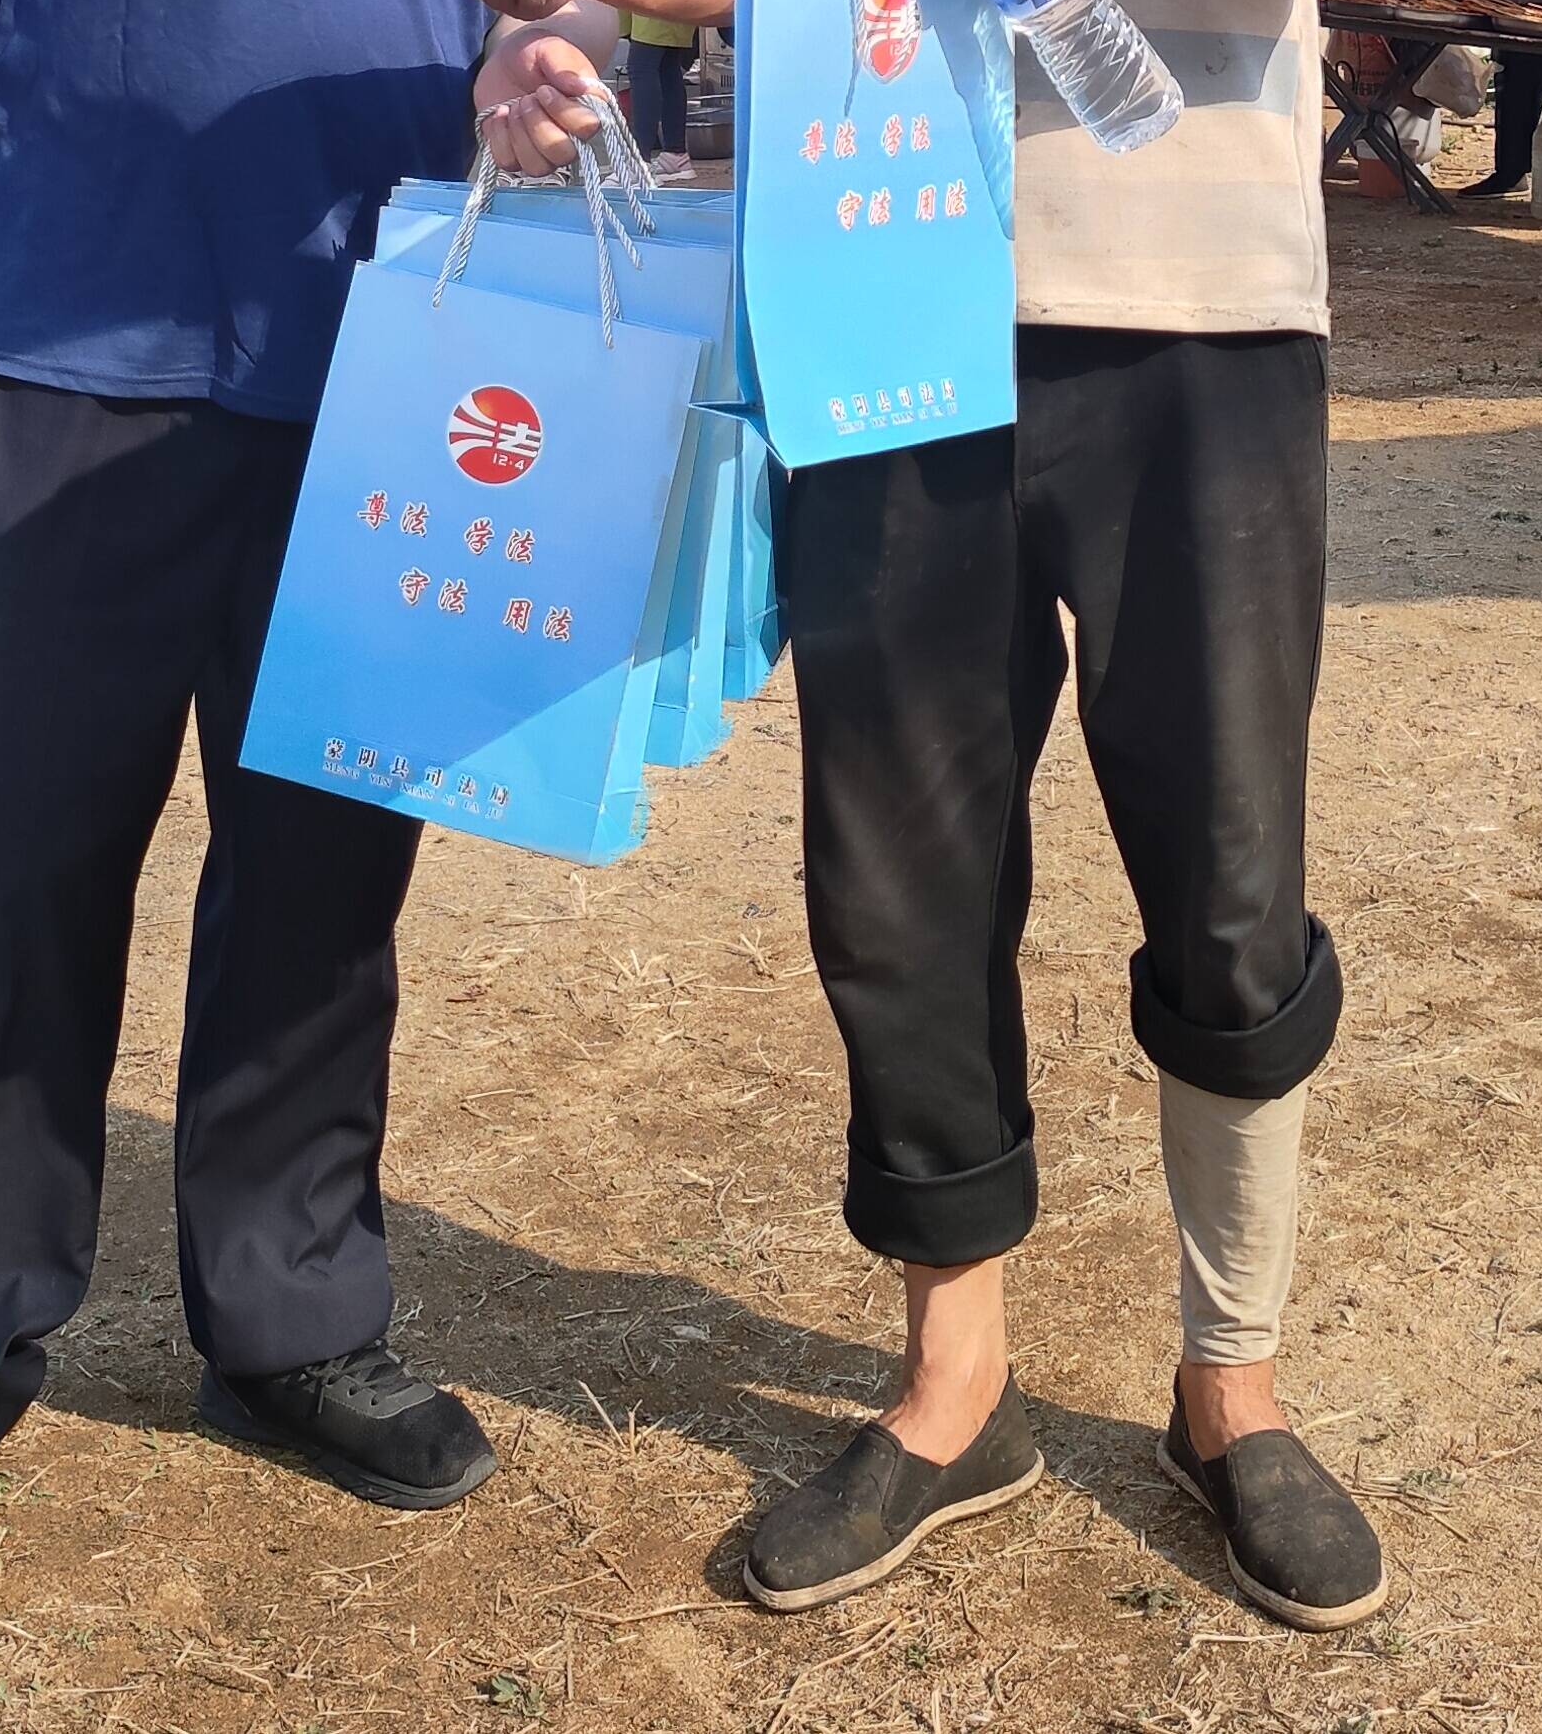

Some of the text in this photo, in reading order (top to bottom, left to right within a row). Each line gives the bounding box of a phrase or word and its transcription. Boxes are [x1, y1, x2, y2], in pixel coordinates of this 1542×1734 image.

[881, 114, 932, 155] 学法
[837, 180, 969, 230] 守法 用法
[358, 491, 535, 564] 尊法 学法
[400, 569, 573, 643] 守法 用法
[325, 738, 509, 806] 蒙阴县司法局
